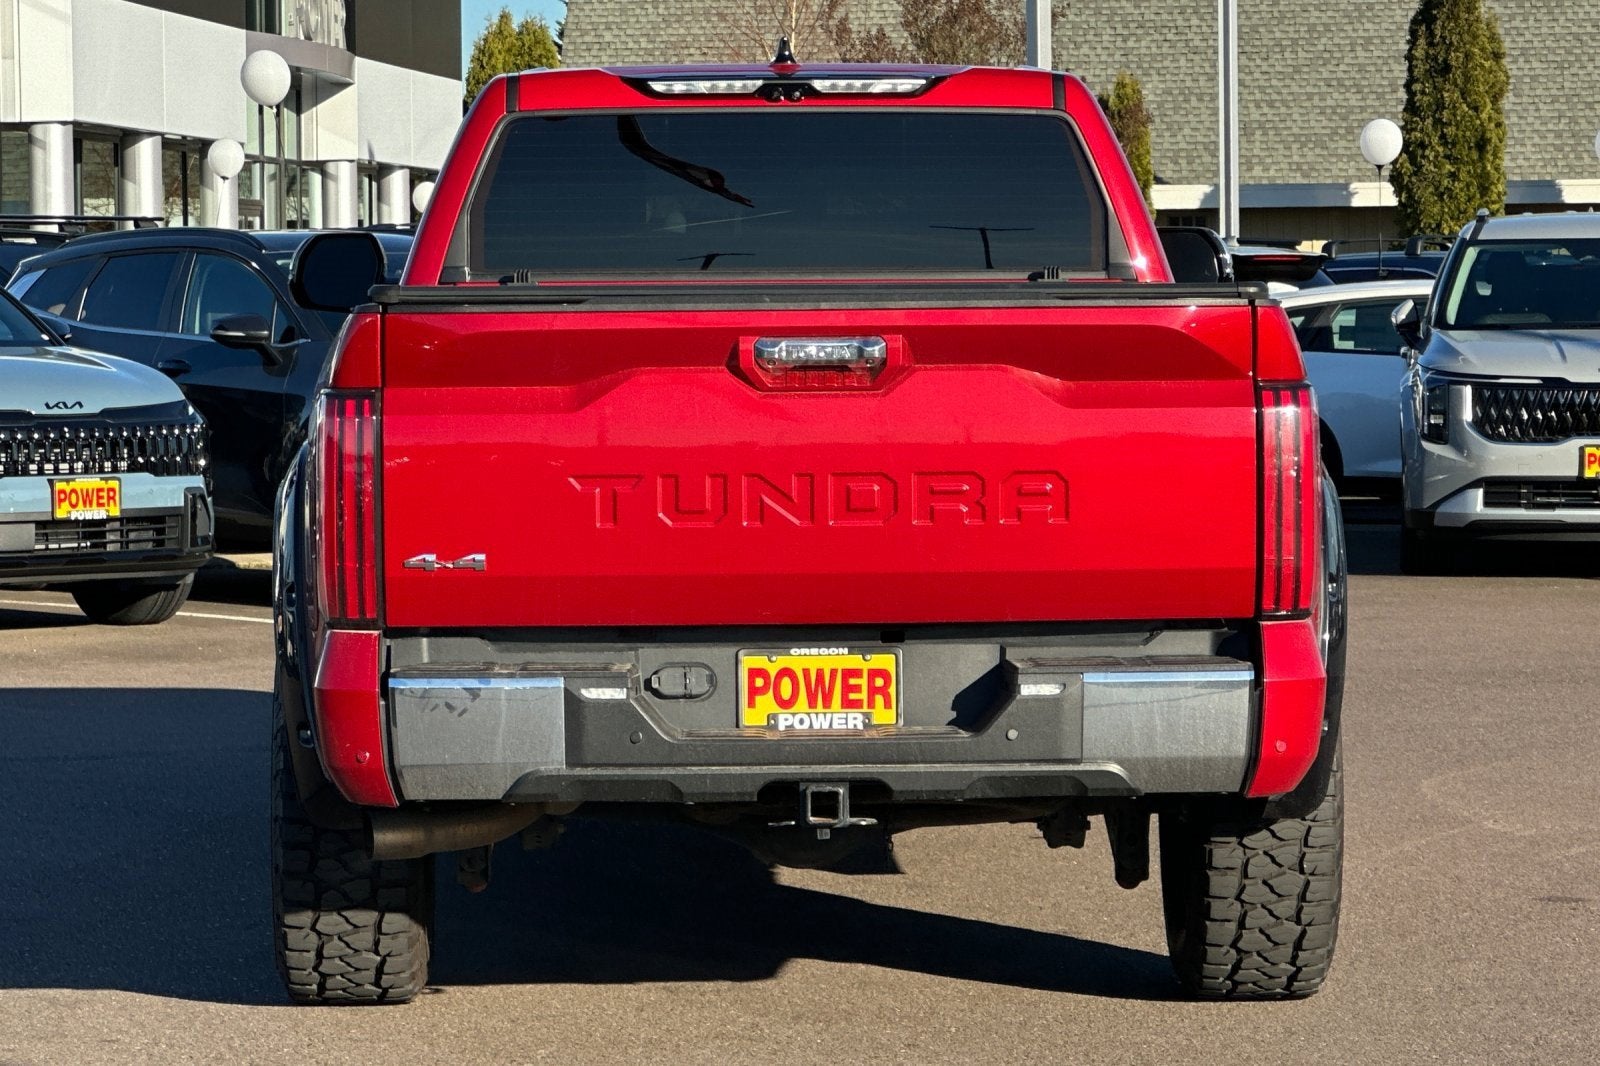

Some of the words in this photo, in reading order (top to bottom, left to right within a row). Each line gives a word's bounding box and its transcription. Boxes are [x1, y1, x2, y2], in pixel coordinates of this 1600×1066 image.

[1587, 453, 1600, 471] P
[58, 487, 117, 509] POWER
[568, 470, 1070, 529] TUNDRA
[70, 510, 107, 520] POWER
[790, 647, 849, 656] OREGON
[747, 667, 893, 710] POWER
[777, 712, 864, 731] POWER
